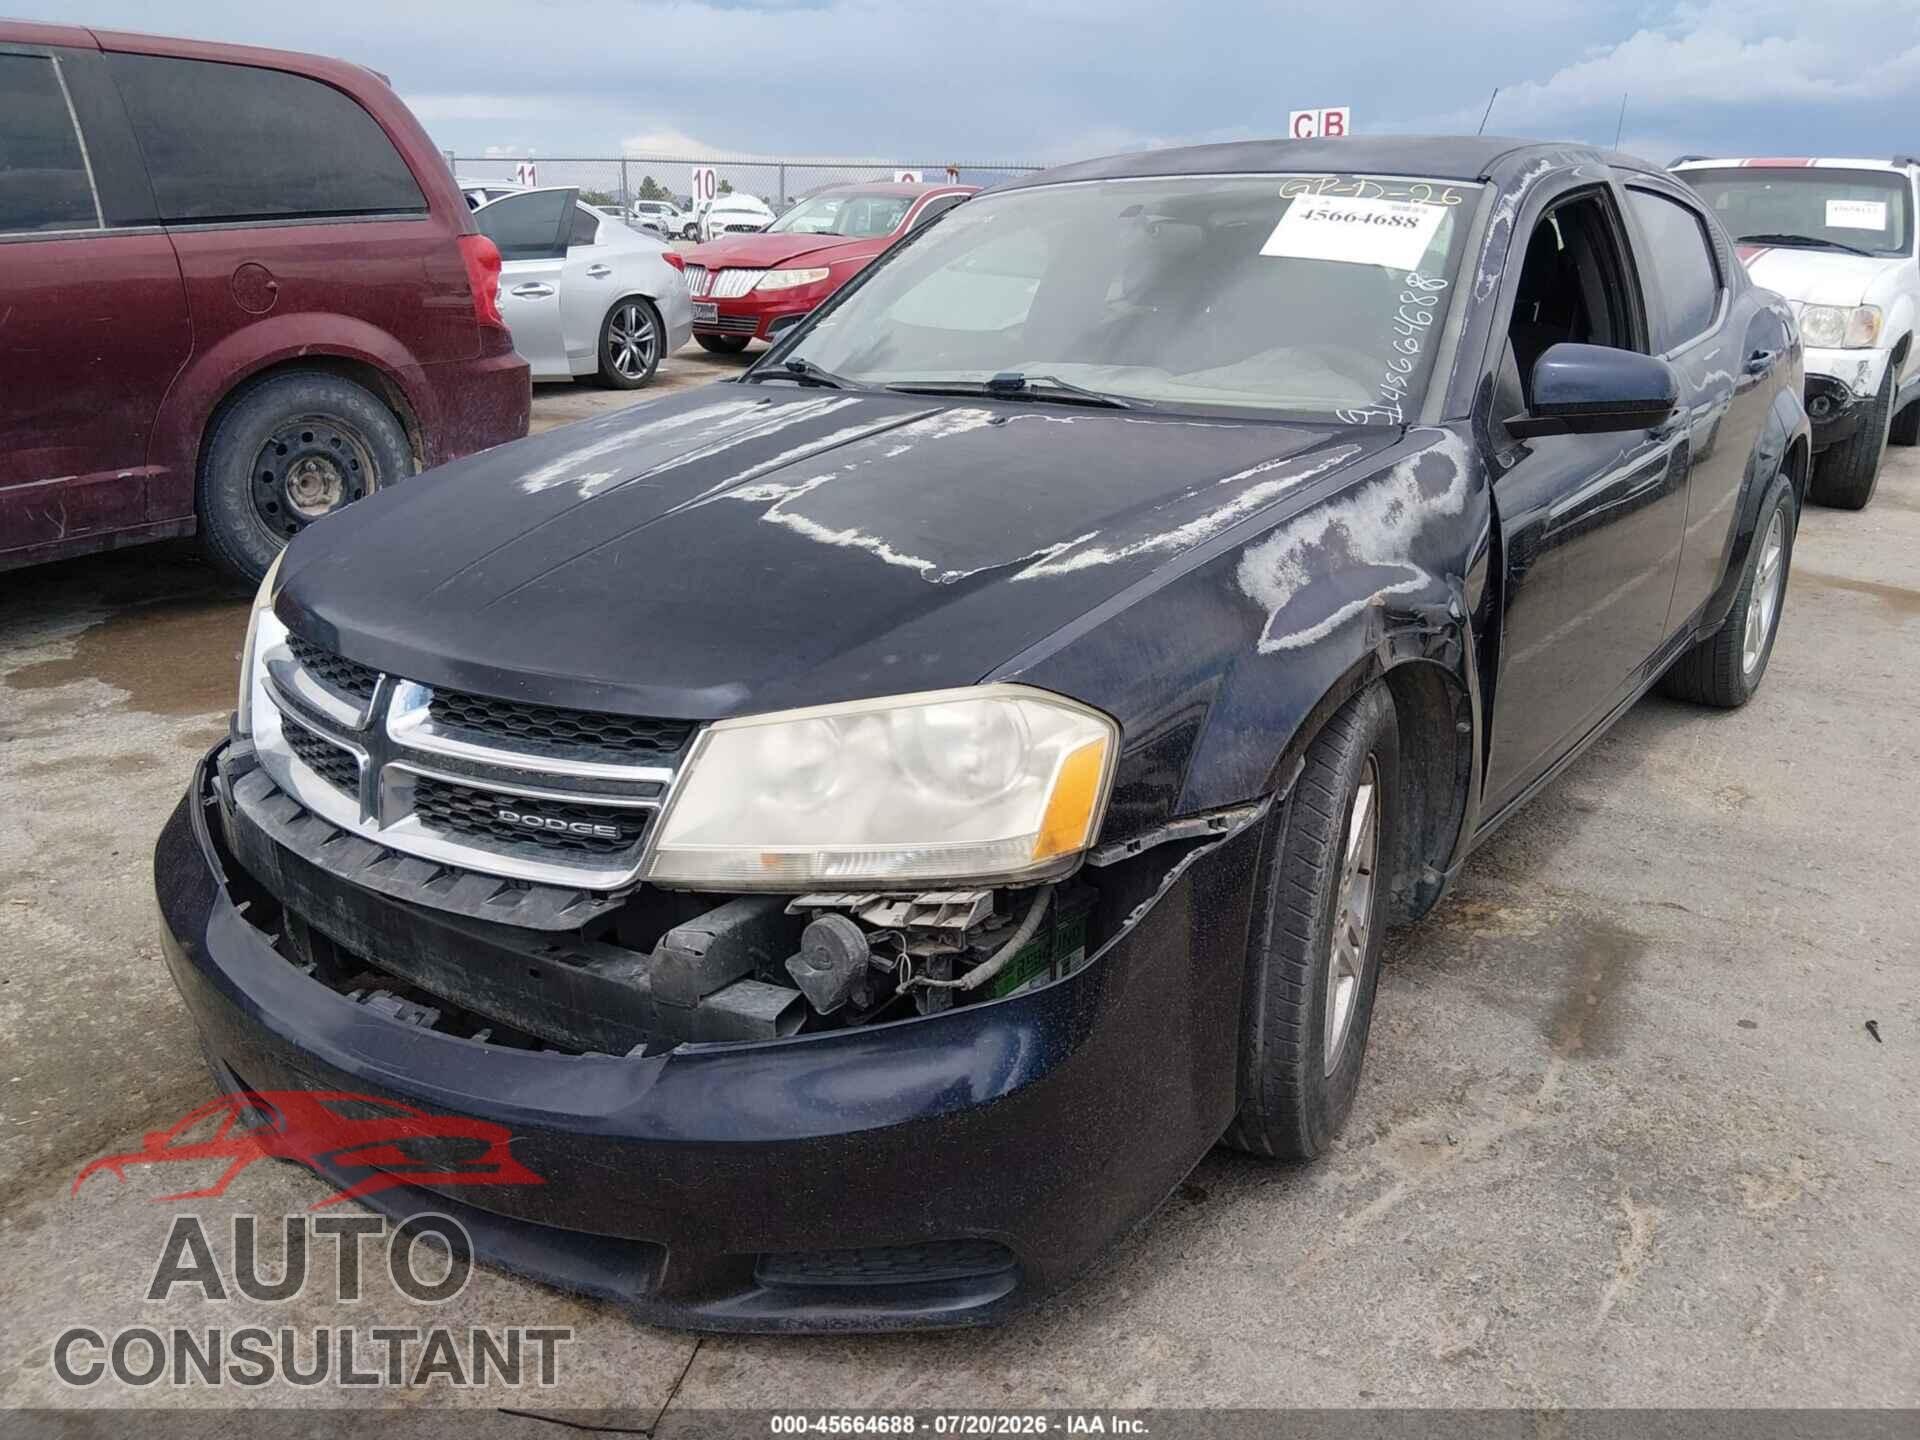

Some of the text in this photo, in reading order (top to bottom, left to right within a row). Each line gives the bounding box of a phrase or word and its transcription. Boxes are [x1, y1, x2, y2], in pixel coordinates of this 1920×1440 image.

[1294, 111, 1344, 139] C B
[517, 165, 537, 187] 11
[693, 169, 716, 201] 10
[1299, 208, 1420, 230] 45664688
[499, 810, 617, 838] DODGE
